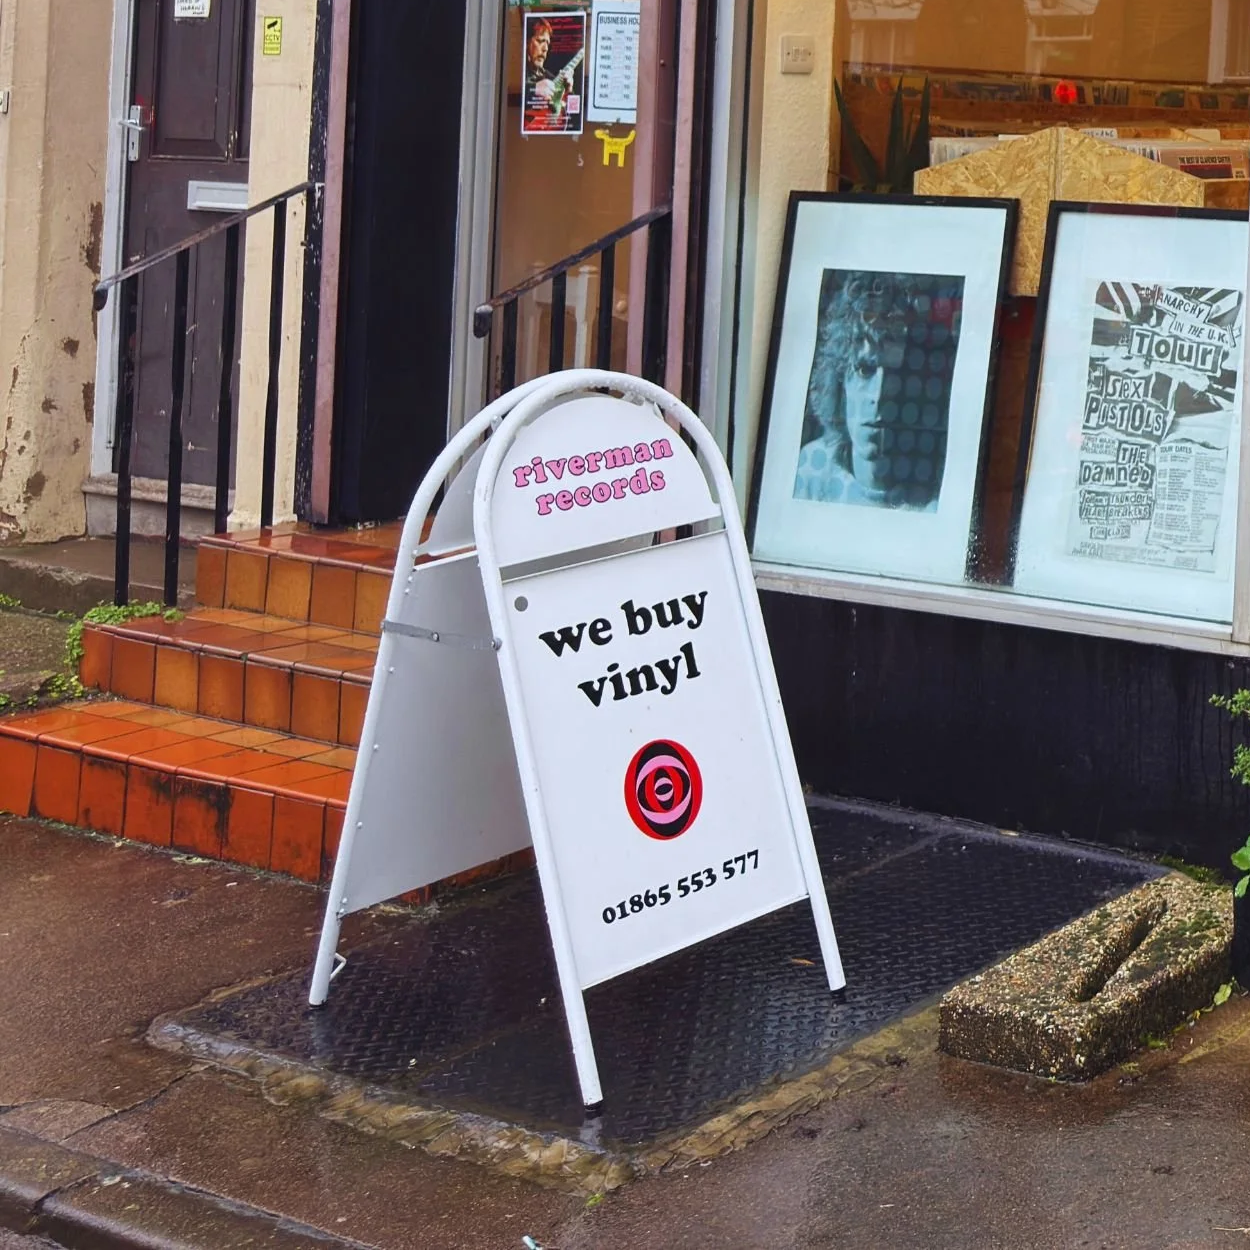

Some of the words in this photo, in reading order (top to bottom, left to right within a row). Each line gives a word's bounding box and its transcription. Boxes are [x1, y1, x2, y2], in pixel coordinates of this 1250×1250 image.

[599, 15, 627, 25] BUSINESS
[1156, 290, 1204, 319] ANARCHY
[1173, 320, 1184, 332] IN
[1188, 323, 1205, 338] THE
[1084, 395, 1162, 432] PISTOLS
[512, 438, 674, 488] riverman
[1120, 446, 1147, 467] THE
[535, 467, 666, 516] records
[538, 618, 613, 657] we
[620, 591, 708, 636] buy
[577, 641, 701, 707] vinyl
[602, 884, 672, 925] 01865
[677, 867, 717, 899] 553
[722, 848, 760, 880] 577
